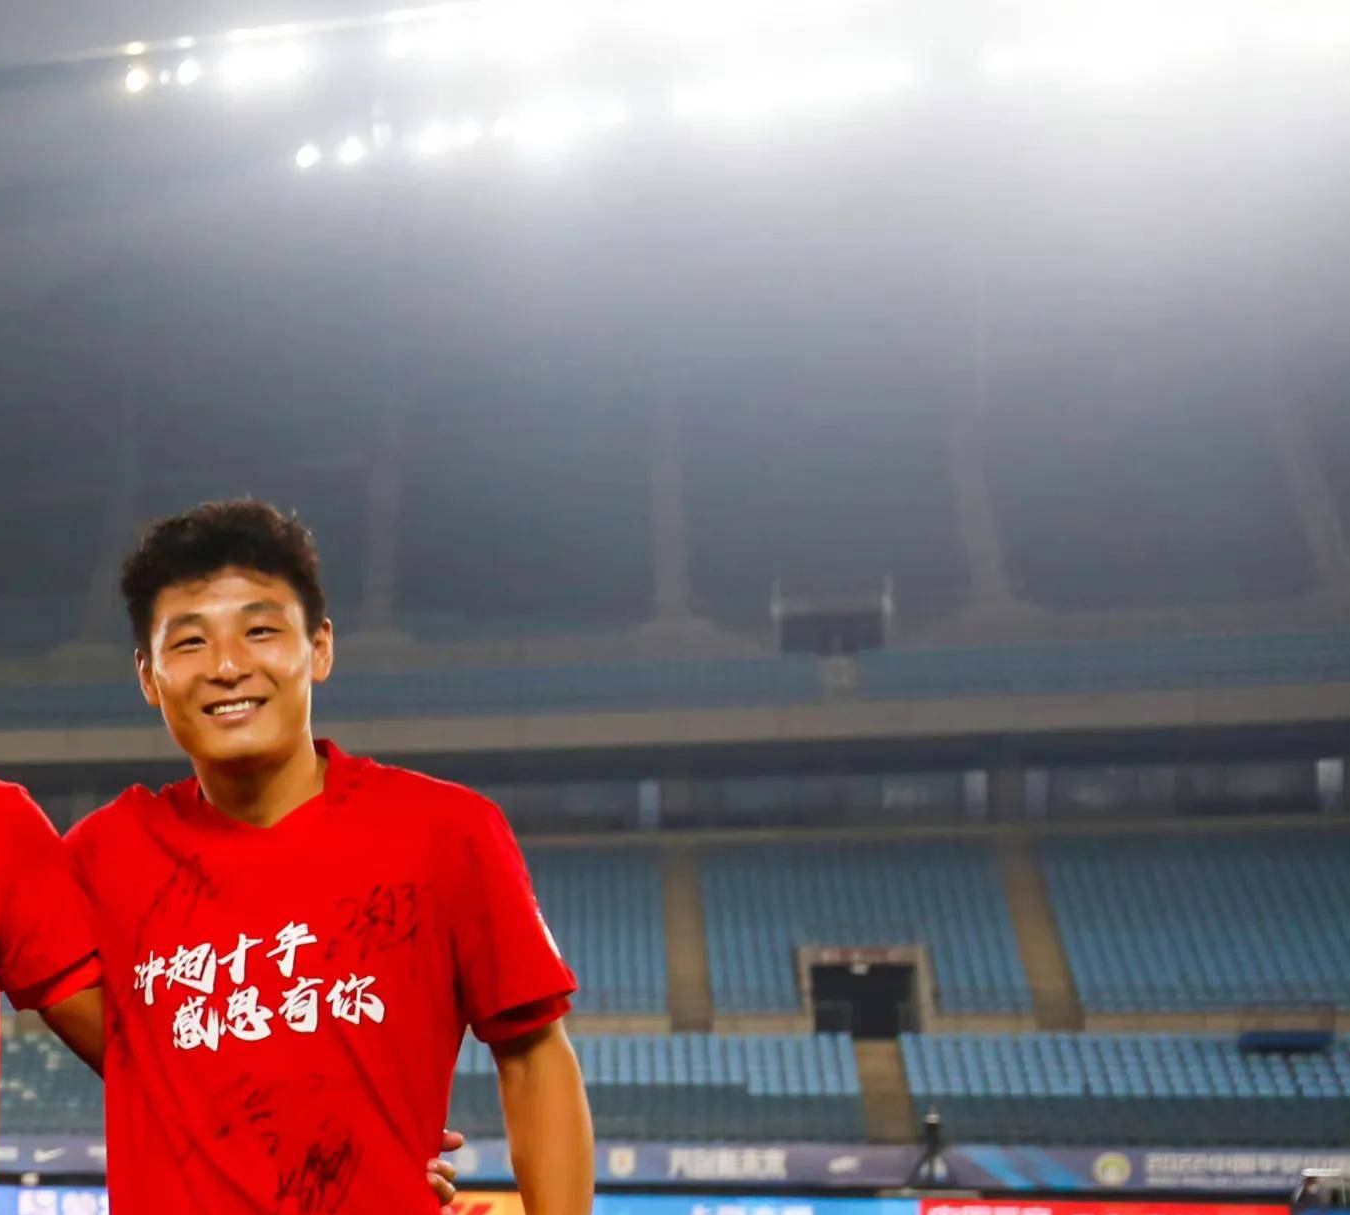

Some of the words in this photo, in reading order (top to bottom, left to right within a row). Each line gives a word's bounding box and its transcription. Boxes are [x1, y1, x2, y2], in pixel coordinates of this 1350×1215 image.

[133, 921, 318, 1005] 冲超十年
[172, 973, 385, 1052] 感恩有你
